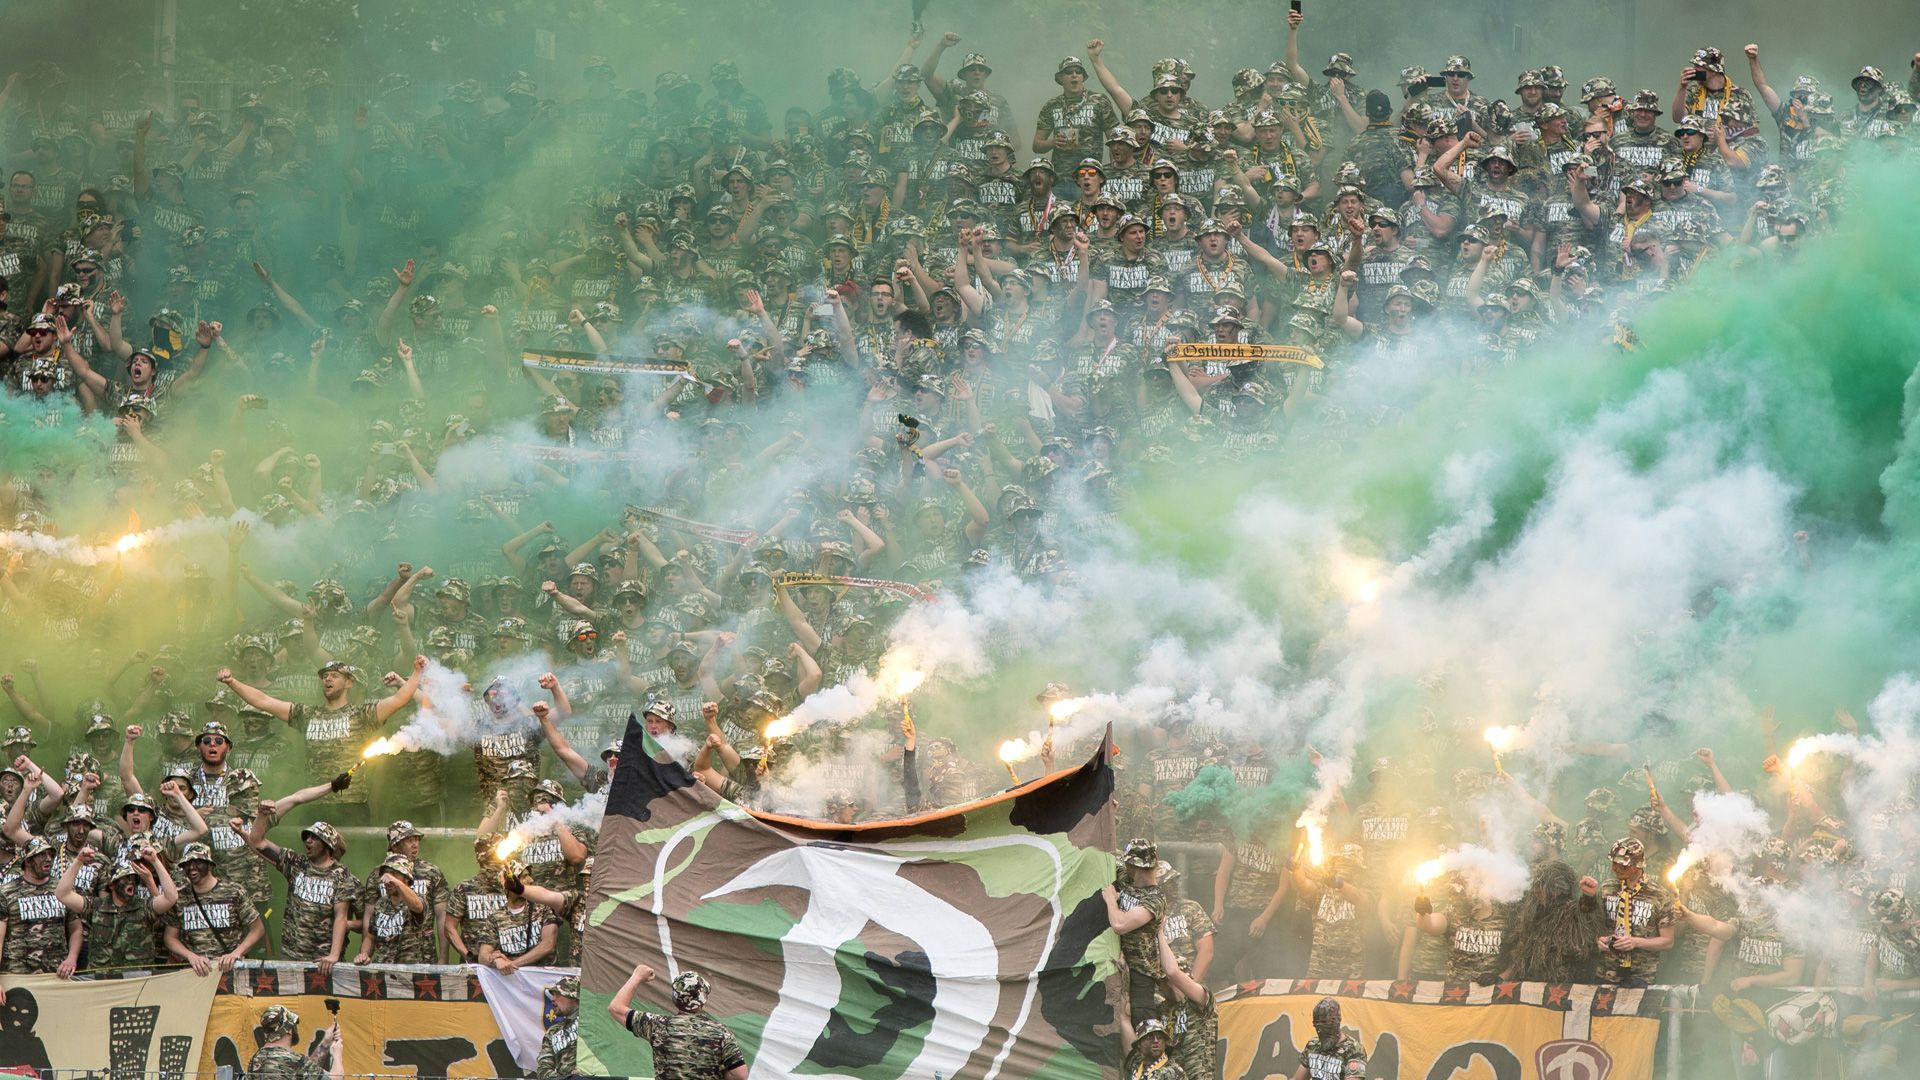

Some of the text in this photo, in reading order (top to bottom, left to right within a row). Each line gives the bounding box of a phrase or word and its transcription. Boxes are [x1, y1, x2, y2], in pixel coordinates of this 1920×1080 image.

[1183, 345, 1245, 358] Ostblock
[212, 831, 242, 843] DYNA
[213, 838, 245, 850] DRESD
[18, 894, 57, 903] FOOTBALLAR
